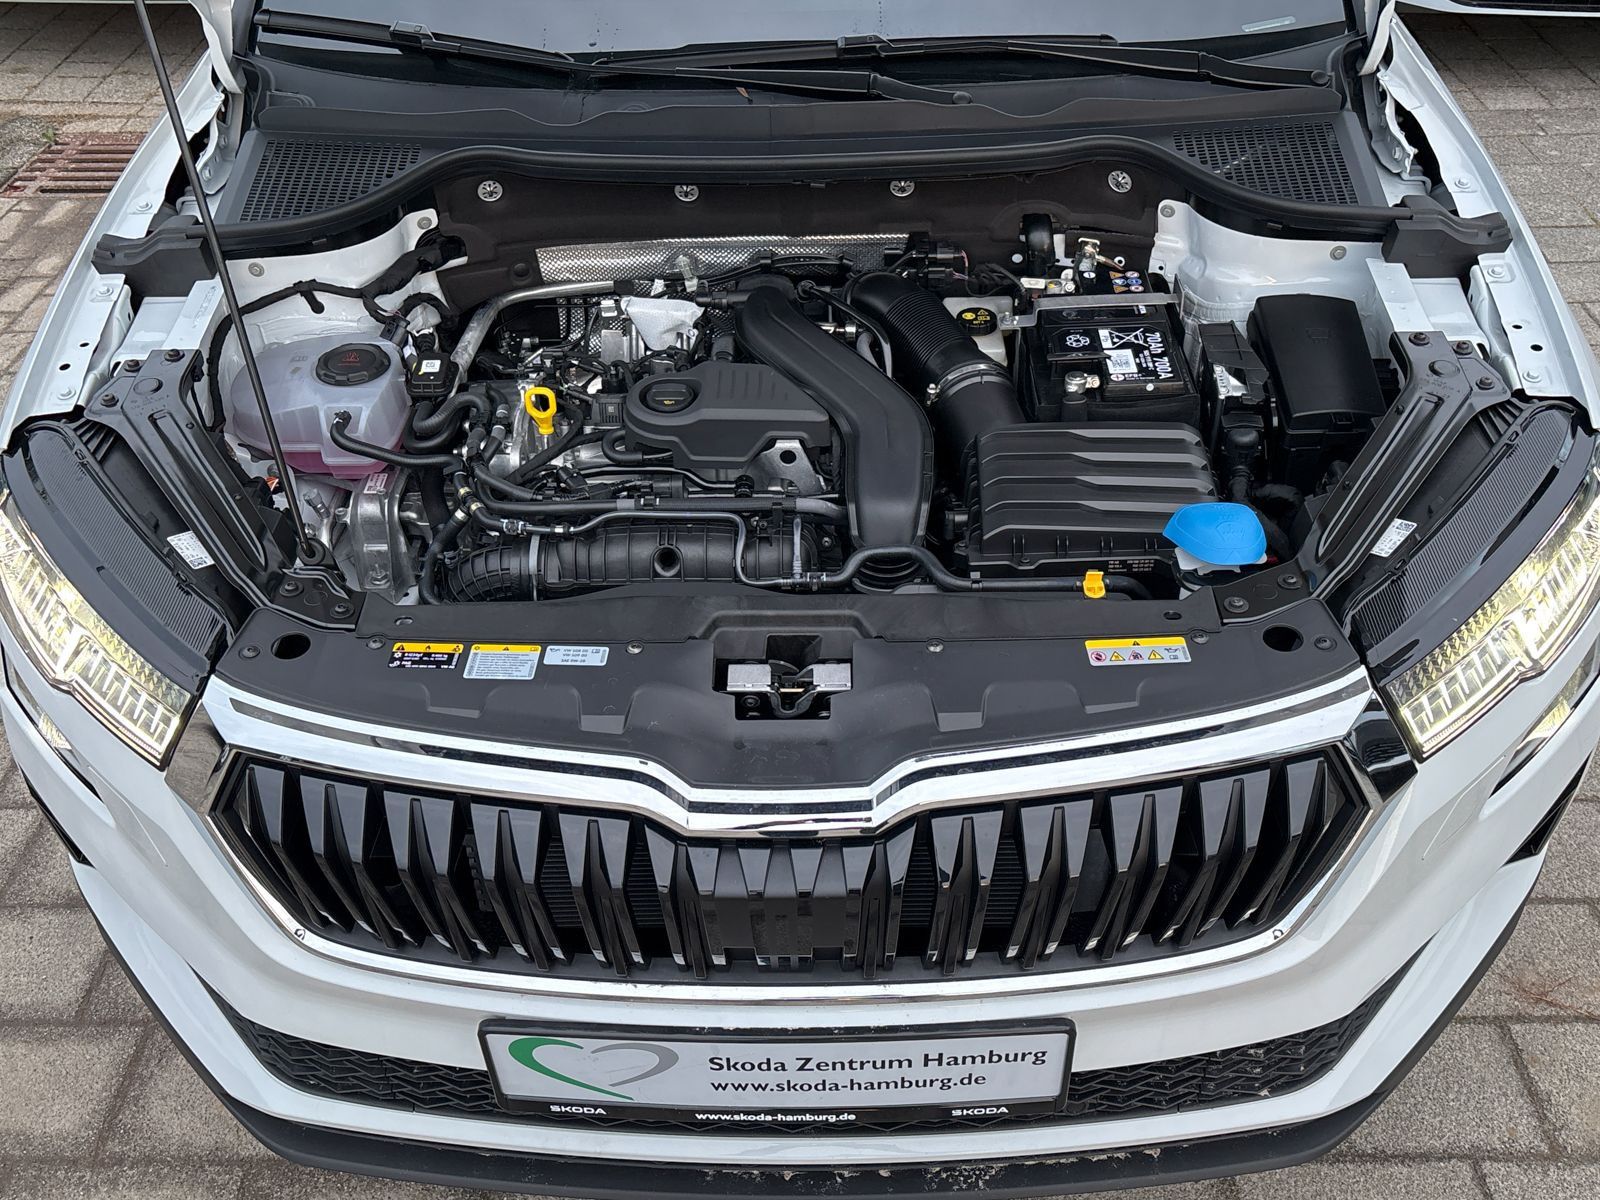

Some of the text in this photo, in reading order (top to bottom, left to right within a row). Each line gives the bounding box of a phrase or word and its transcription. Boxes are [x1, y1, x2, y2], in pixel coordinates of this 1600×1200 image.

[1145, 332, 1165, 354] 70Ah
[1153, 356, 1174, 379] 700A
[708, 1050, 1048, 1072] Skoda Zentrum Hamburg
[710, 1073, 987, 1092] www.skoda-hamburg.de
[549, 1104, 607, 1115] SKODA
[695, 1112, 857, 1123] www.skoda-hamburg.de
[951, 1106, 1009, 1117] SKODA
